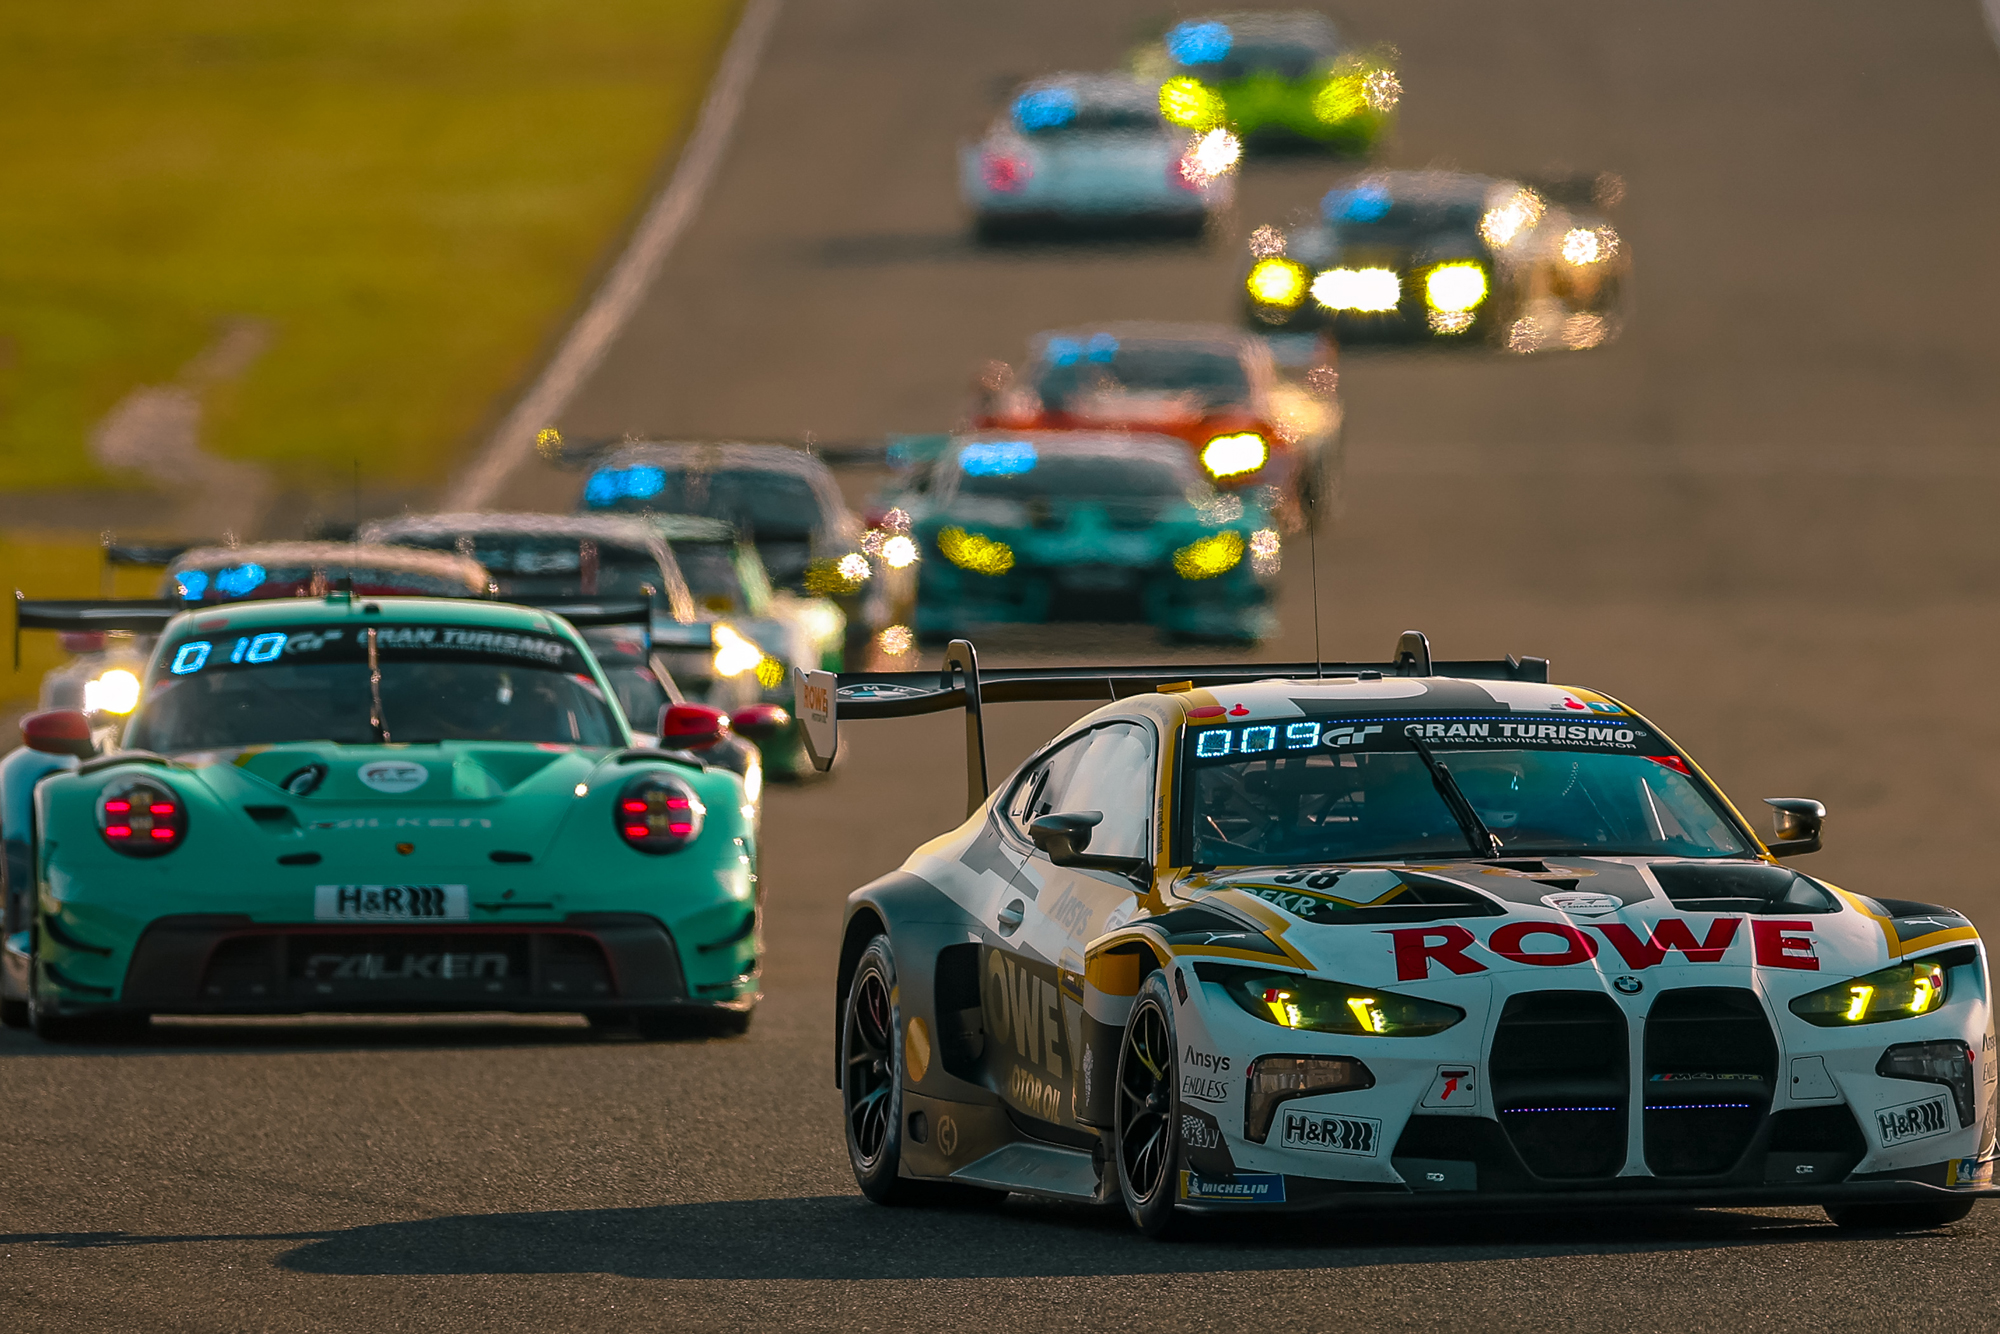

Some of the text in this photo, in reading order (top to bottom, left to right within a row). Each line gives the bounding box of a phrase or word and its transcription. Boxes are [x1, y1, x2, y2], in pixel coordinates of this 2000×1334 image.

[1196, 721, 1384, 757] 009 GT
[1403, 723, 1490, 737] GRAN
[1553, 738, 1628, 750] SIMULATOR
[1372, 917, 1821, 982] ROWE
[986, 948, 1063, 1079] OWE
[1184, 1045, 1232, 1074] Ansys
[1011, 1064, 1043, 1114] OTOR
[1043, 1083, 1062, 1125] OIL
[1182, 1075, 1230, 1099] ENDLESS
[1201, 1182, 1270, 1194] MICHELIN
